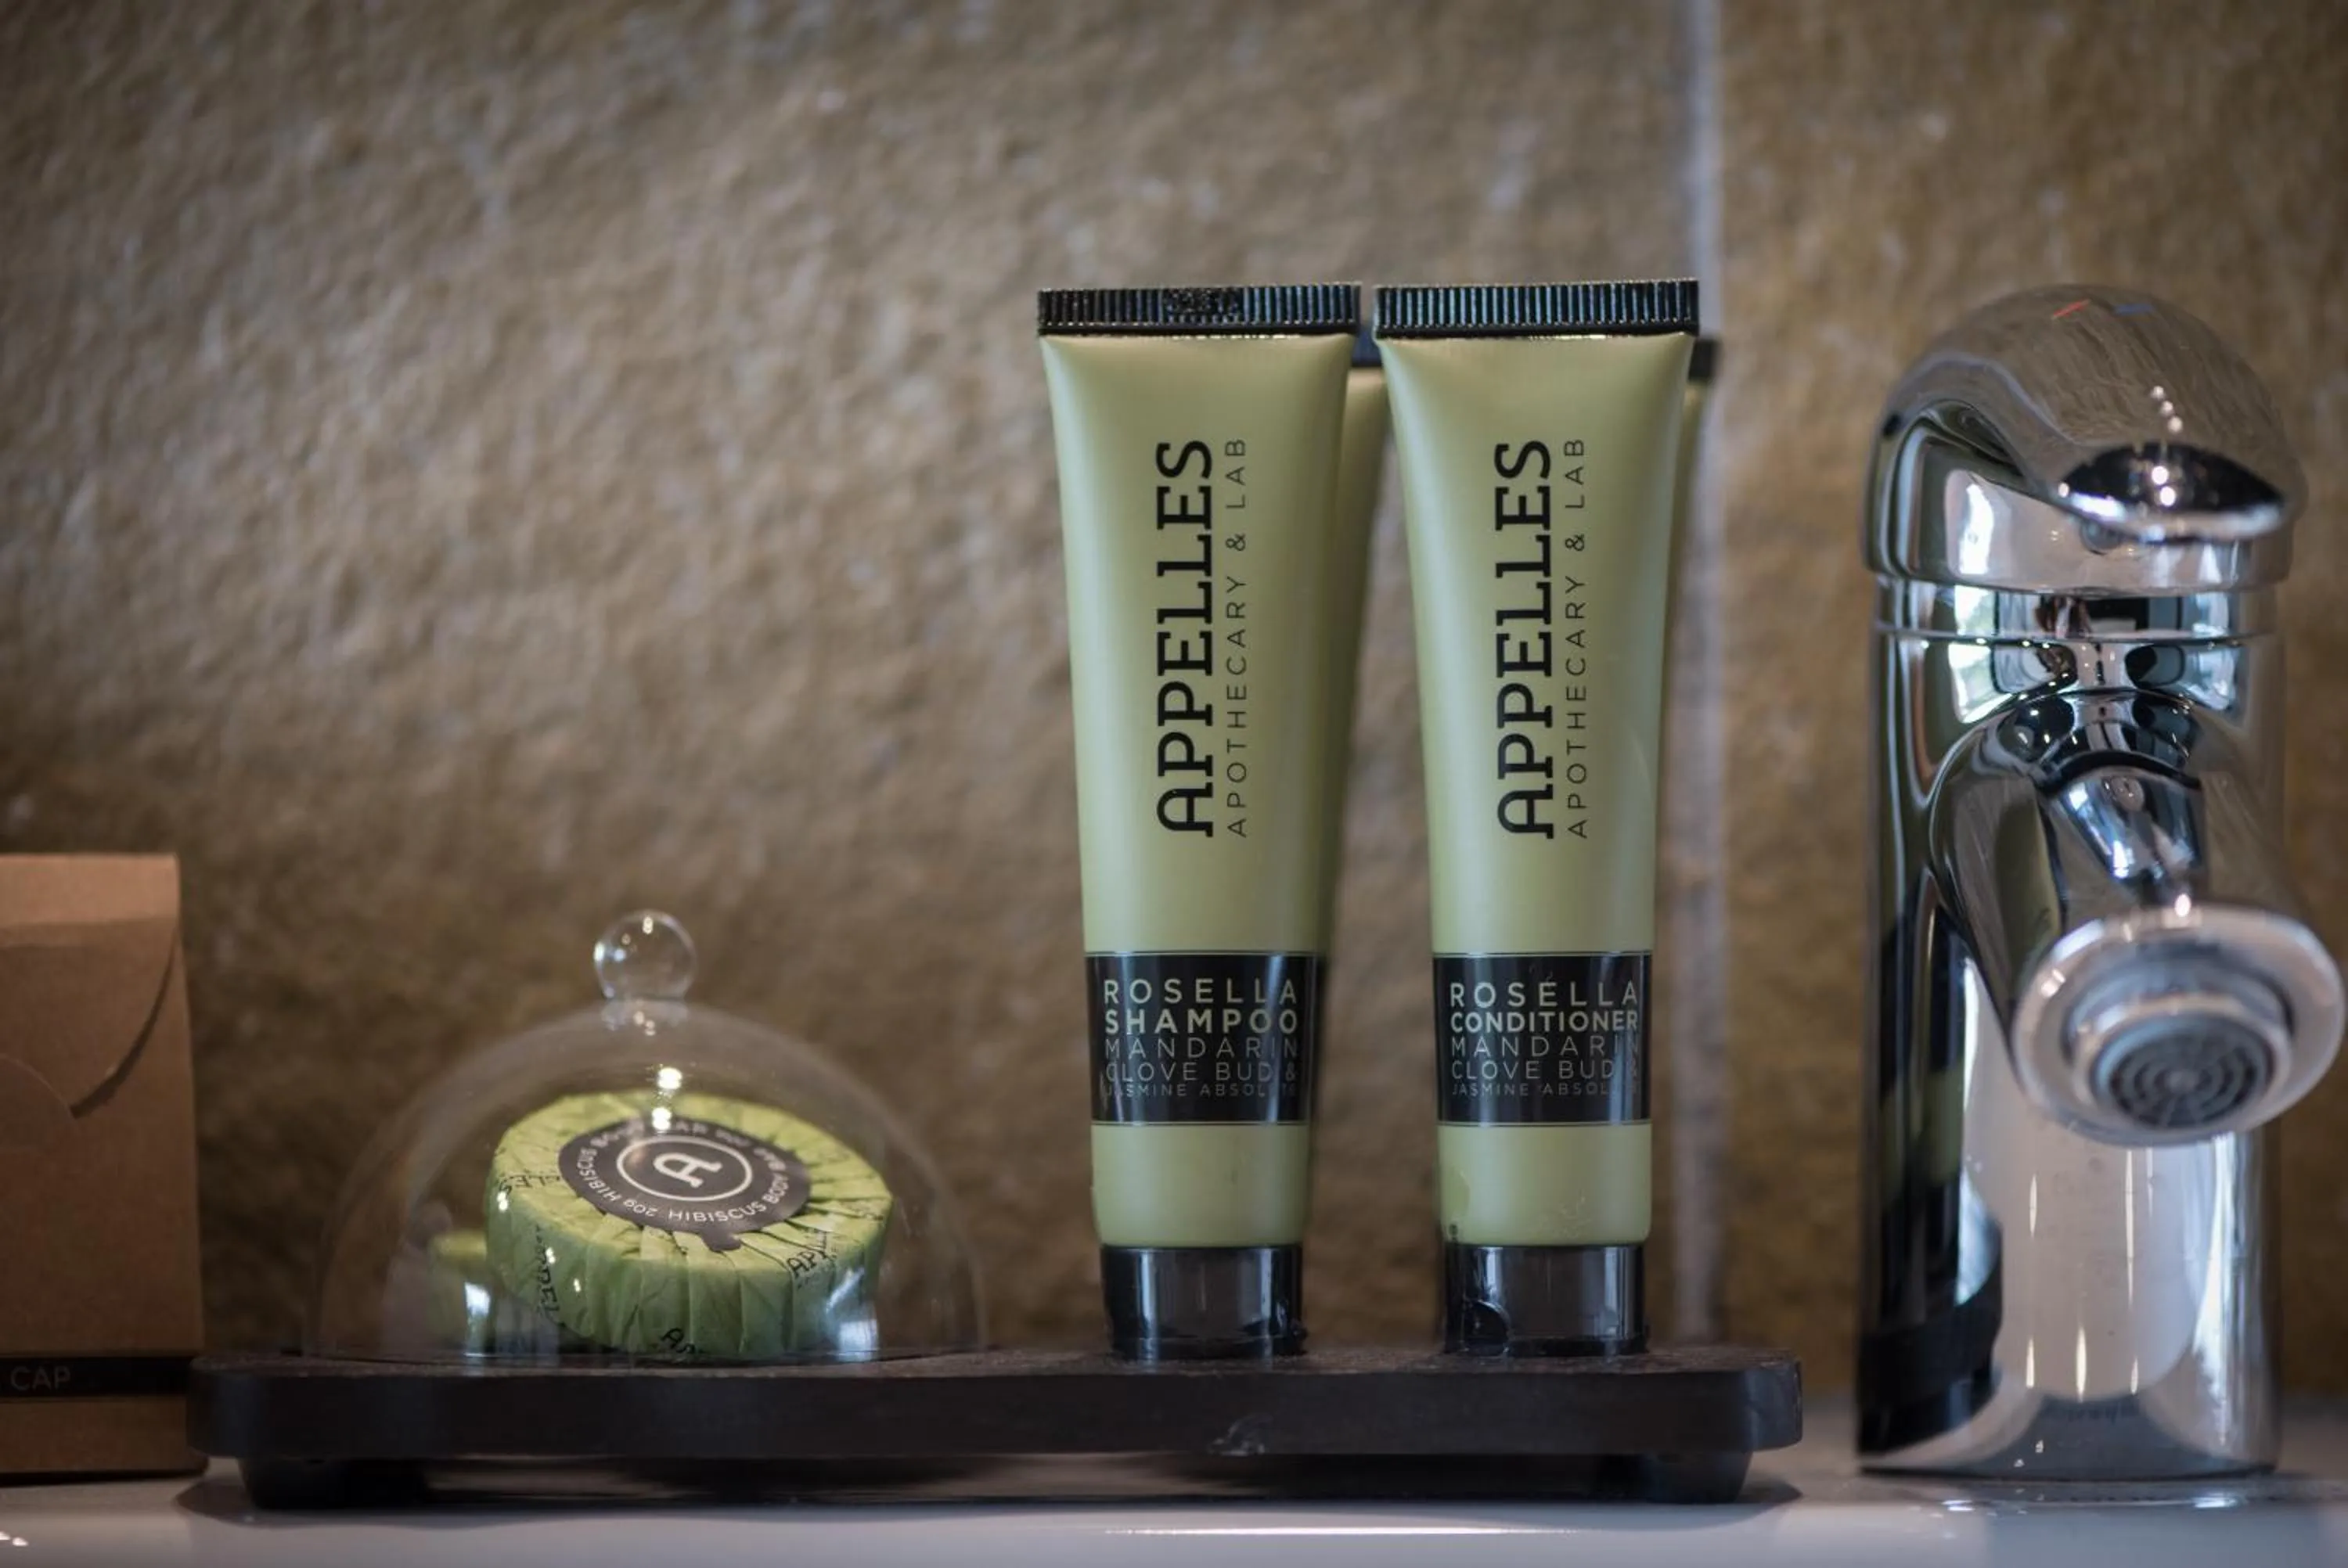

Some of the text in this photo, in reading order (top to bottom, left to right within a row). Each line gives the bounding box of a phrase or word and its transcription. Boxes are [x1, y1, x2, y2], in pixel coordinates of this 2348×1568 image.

[1155, 440, 1213, 837] APPELLES
[1224, 438, 1248, 838] APOTHECARY & LAB
[1493, 440, 1554, 840] APPELLES
[1564, 438, 1587, 840] APOTHECARY & LAB
[1104, 979, 1297, 1005] ROSELLA
[1449, 980, 1638, 1008] ROSELLA
[1104, 1008, 1298, 1035] SHAMPOO
[1449, 1011, 1638, 1034] CONDITIONER
[1104, 1037, 1298, 1059] MANDARIN
[1450, 1036, 1639, 1057] MANDARIN
[1105, 1062, 1198, 1083] CLOVE
[1215, 1061, 1274, 1082] BUD
[1451, 1059, 1541, 1081] CLOVE
[1558, 1059, 1615, 1080] BUD
[1104, 1083, 1187, 1098] JSMINE
[1451, 1082, 1529, 1097] JASMINE
[653, 1152, 723, 1189] A
[668, 1200, 767, 1221] HIBISCUS
[10, 1365, 71, 1391] CAP
